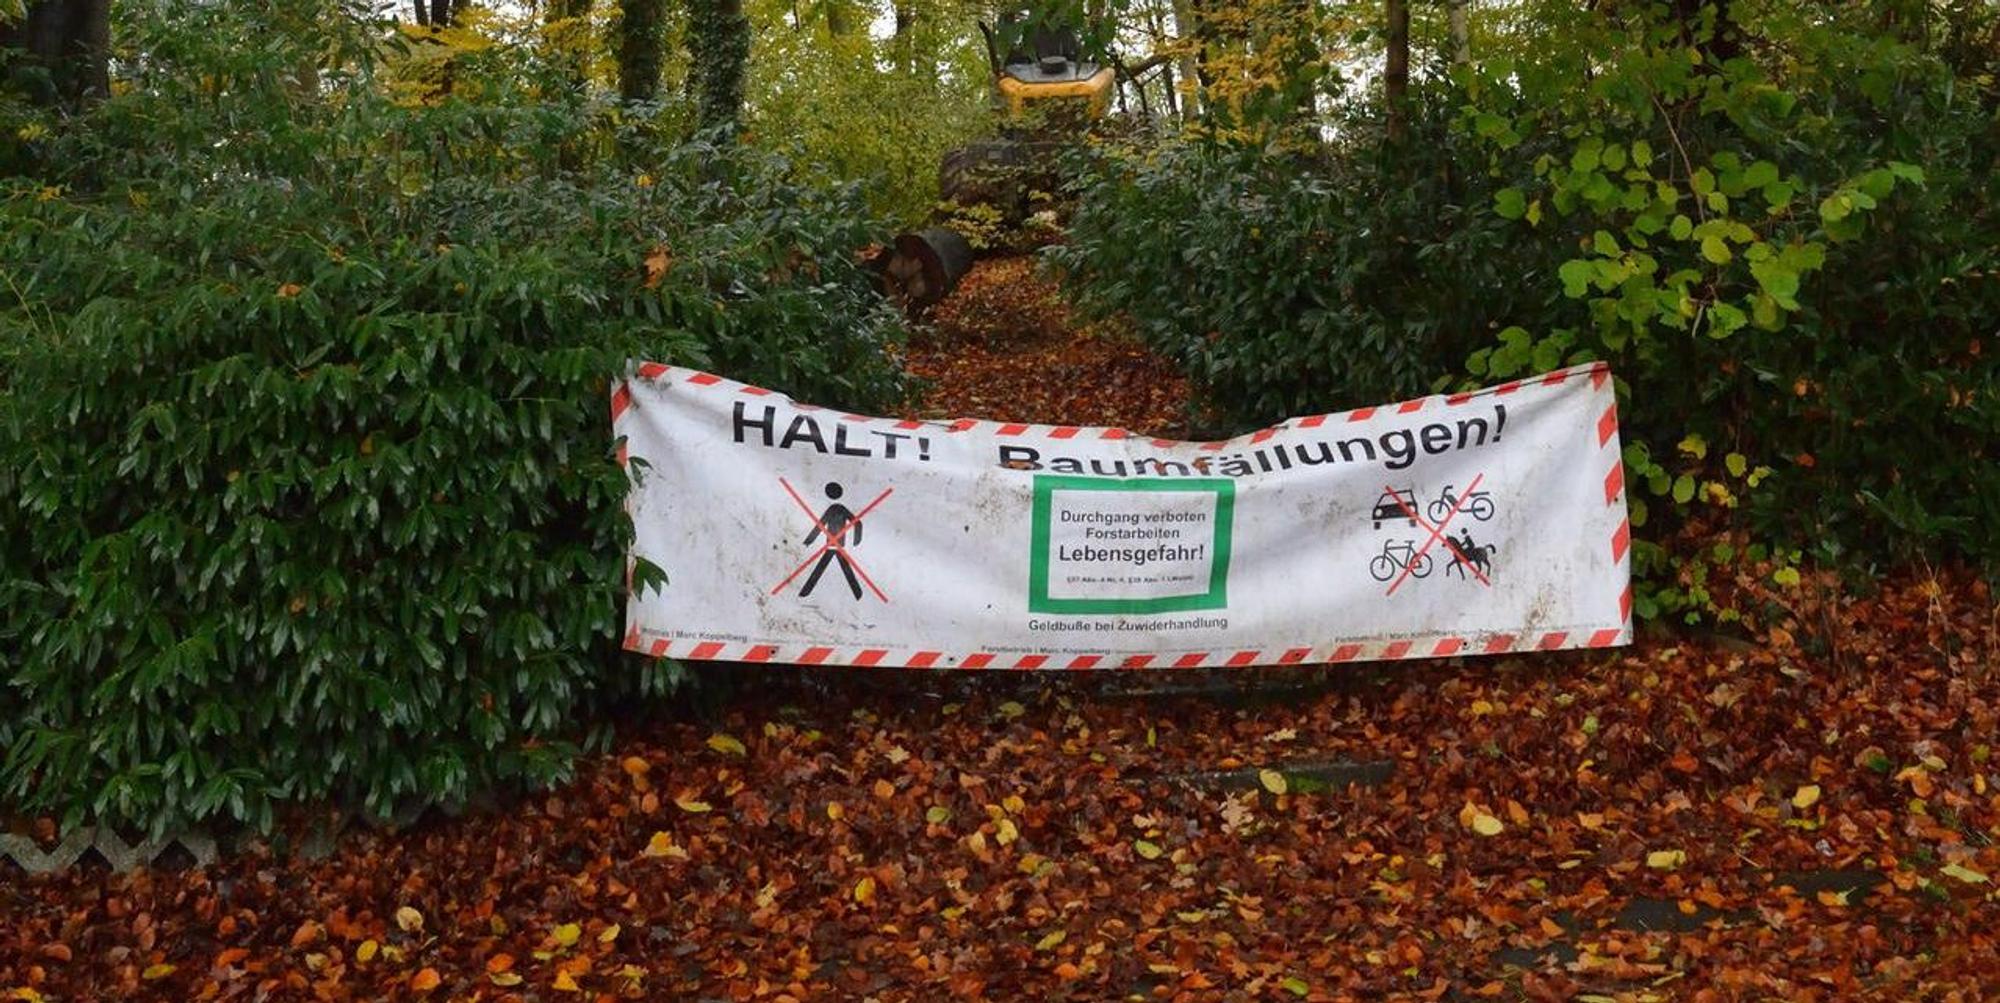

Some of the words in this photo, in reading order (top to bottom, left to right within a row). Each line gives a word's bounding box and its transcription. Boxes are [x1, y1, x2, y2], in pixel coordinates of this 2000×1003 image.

[733, 401, 930, 461] HALT!
[997, 404, 1507, 477] Baumfällungen!
[1061, 510, 1140, 526] Durchgang
[1144, 511, 1206, 523] verboten
[1086, 527, 1180, 539] Forstarbeiten
[1059, 544, 1204, 565] Lebensgefahr!
[1028, 619, 1091, 632] Geldbuße
[1095, 619, 1114, 631] bei
[1118, 617, 1228, 632] Zuwiderhandlung
[676, 630, 697, 639] Marc
